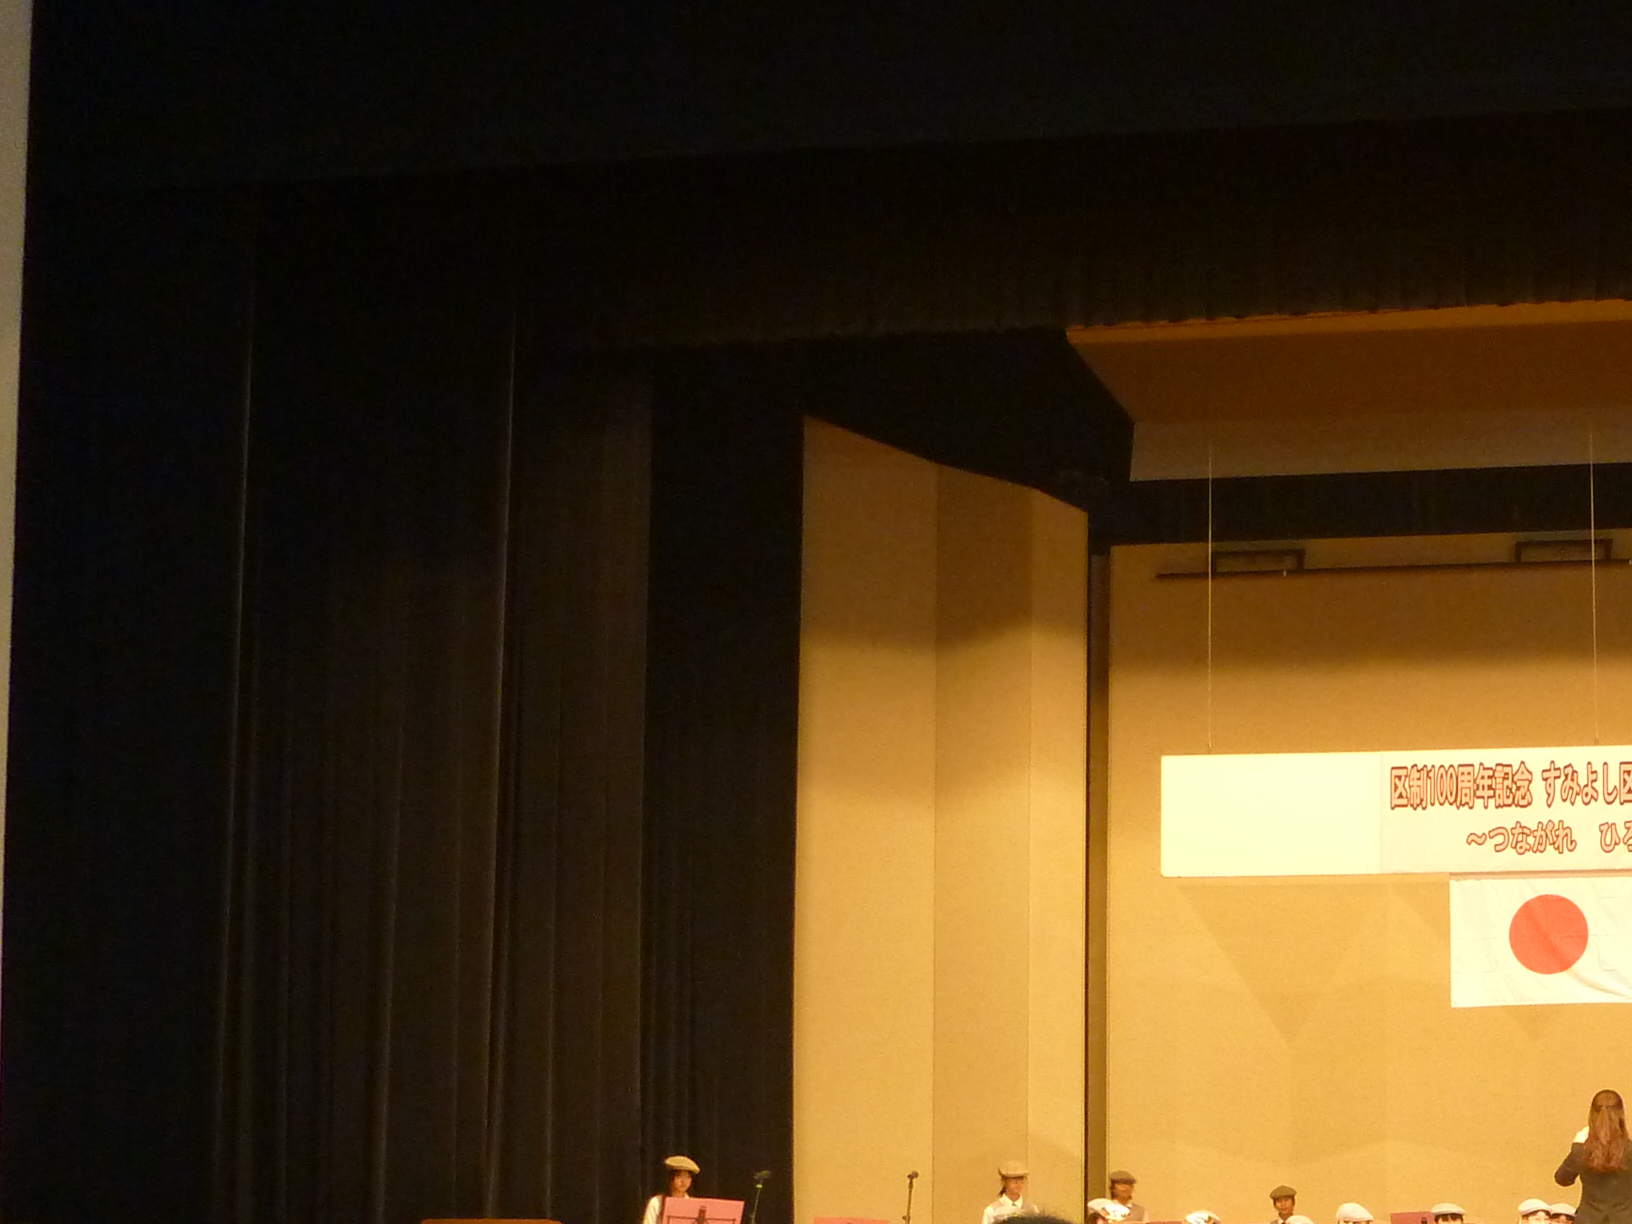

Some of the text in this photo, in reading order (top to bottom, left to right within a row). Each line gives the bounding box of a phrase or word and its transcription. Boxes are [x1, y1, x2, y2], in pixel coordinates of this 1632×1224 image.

[1390, 761, 1533, 810] 区制100周年記念
